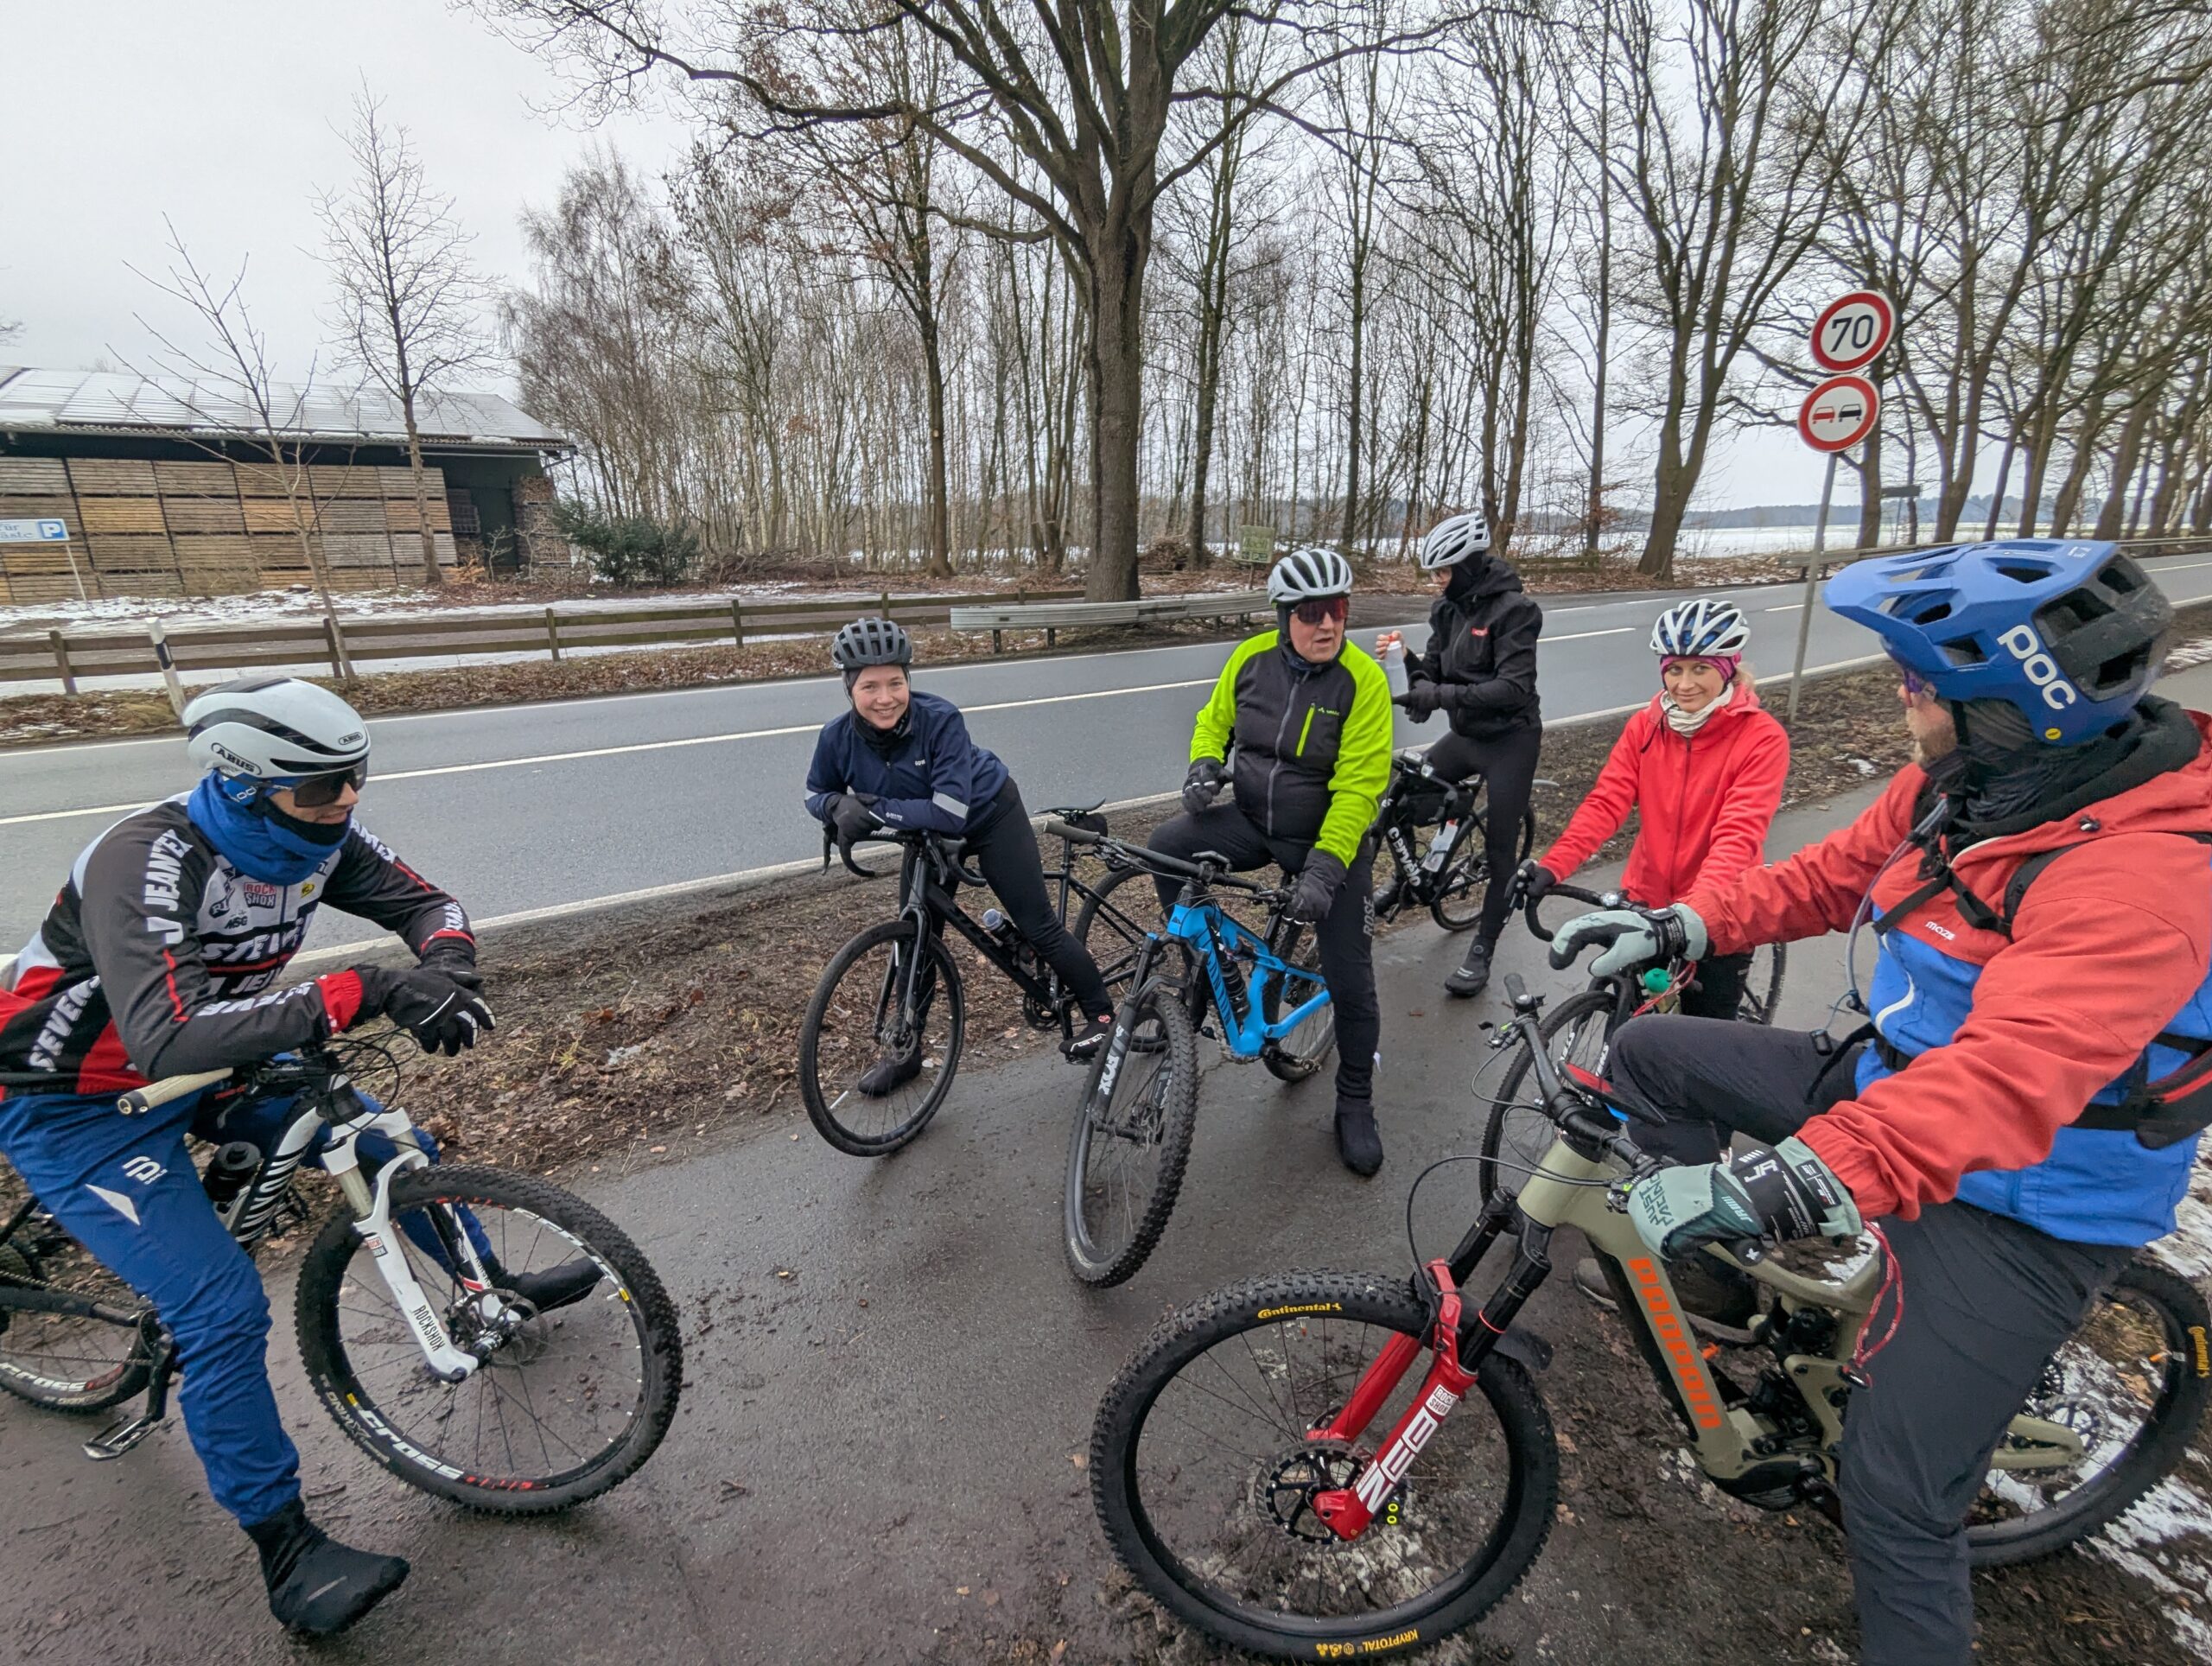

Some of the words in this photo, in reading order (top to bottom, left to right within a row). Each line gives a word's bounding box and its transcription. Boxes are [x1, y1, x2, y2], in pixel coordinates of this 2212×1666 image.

[1830, 315, 1874, 353] 70
[41, 523, 61, 537] P
[342, 733, 361, 744] ABUS
[217, 747, 257, 773] ABUS
[245, 883, 276, 895] ROCK
[245, 893, 276, 906] SHOX
[1363, 896, 1375, 937] ROSE
[1098, 1053, 1120, 1096] FOX
[1257, 1302, 1331, 1319] Continental
[412, 1305, 445, 1352] ROCKSHOX
[1429, 1397, 1448, 1414] SHOX
[1434, 1387, 1458, 1406] ROCK
[1362, 1628, 1419, 1652] KRYPTOTAL
